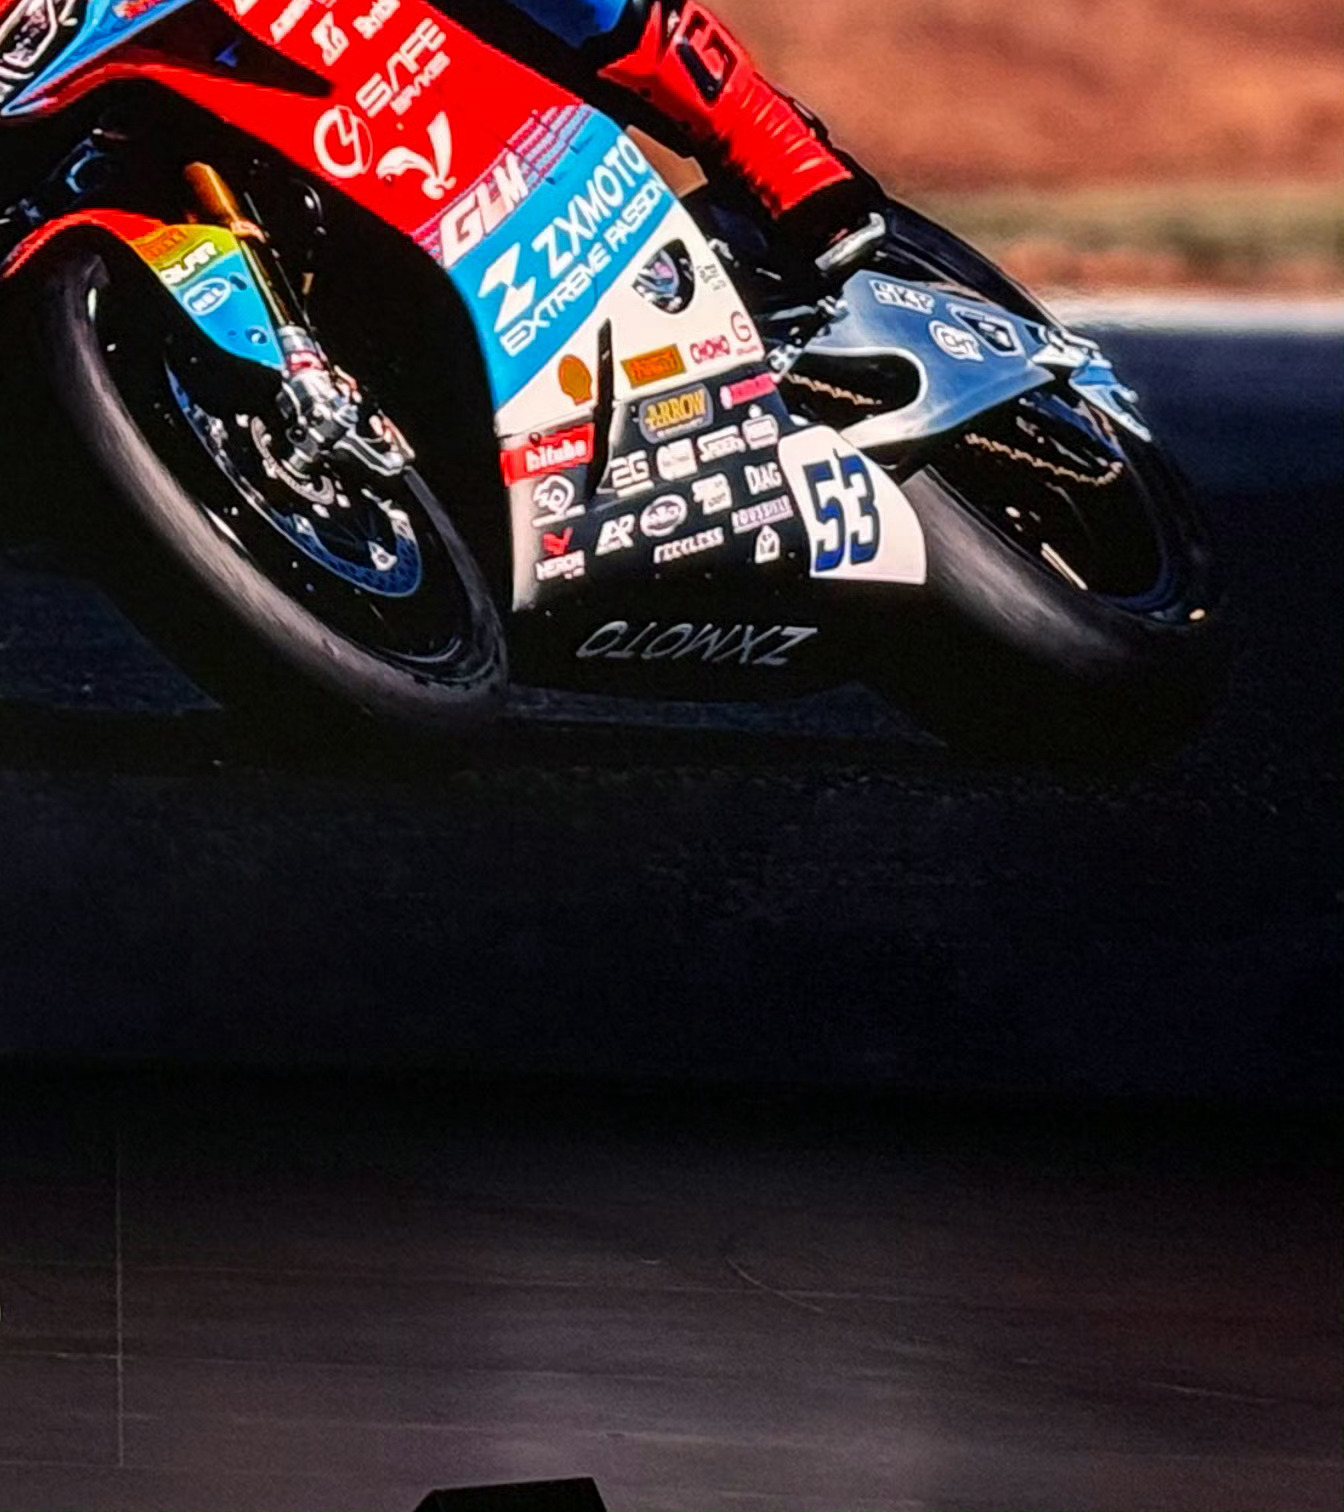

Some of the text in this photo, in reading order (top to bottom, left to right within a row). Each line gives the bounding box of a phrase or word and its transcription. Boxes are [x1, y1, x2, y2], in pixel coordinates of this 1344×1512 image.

[442, 152, 530, 268] GLM
[531, 133, 649, 279] ZXMOTO
[803, 455, 880, 571] 53
